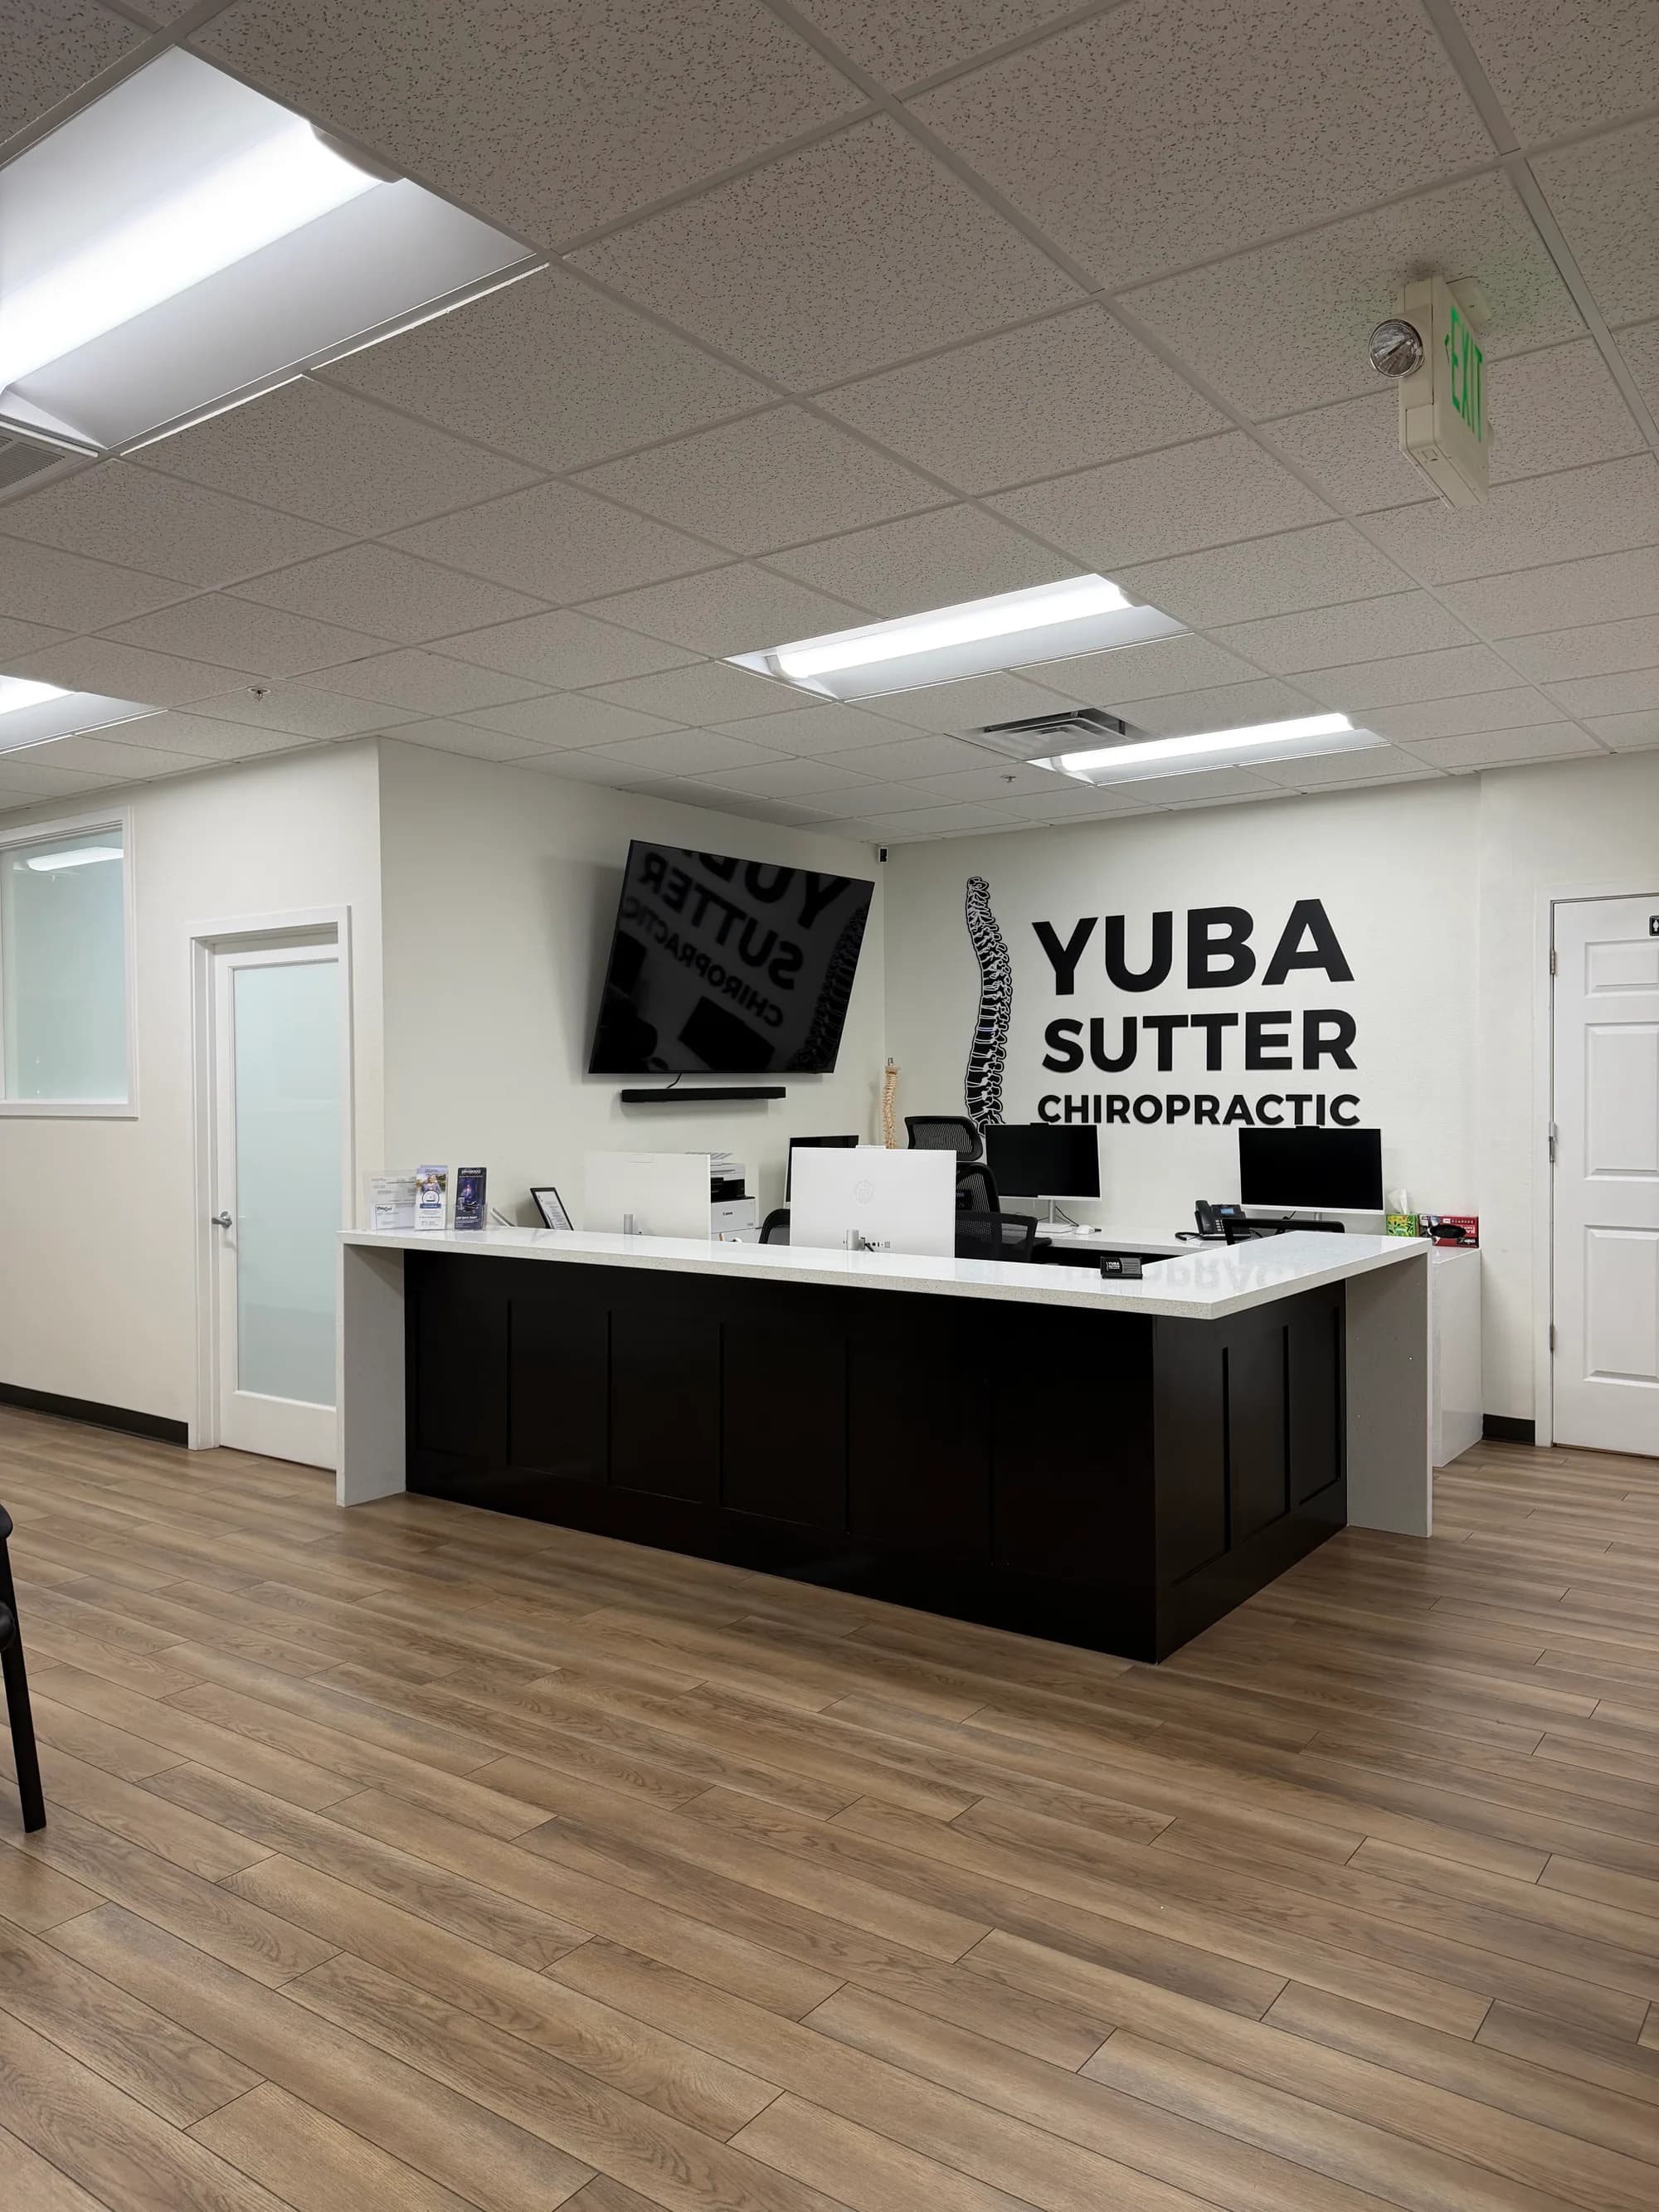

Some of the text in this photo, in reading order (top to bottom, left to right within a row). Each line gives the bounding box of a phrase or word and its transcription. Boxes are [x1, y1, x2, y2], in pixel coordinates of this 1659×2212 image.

[1451, 305, 1483, 444] EXIT
[1031, 898, 1355, 996] YUBA
[1041, 1009, 1358, 1074] SUTTER
[1037, 1093, 1361, 1127] CHIROPRACTIC
